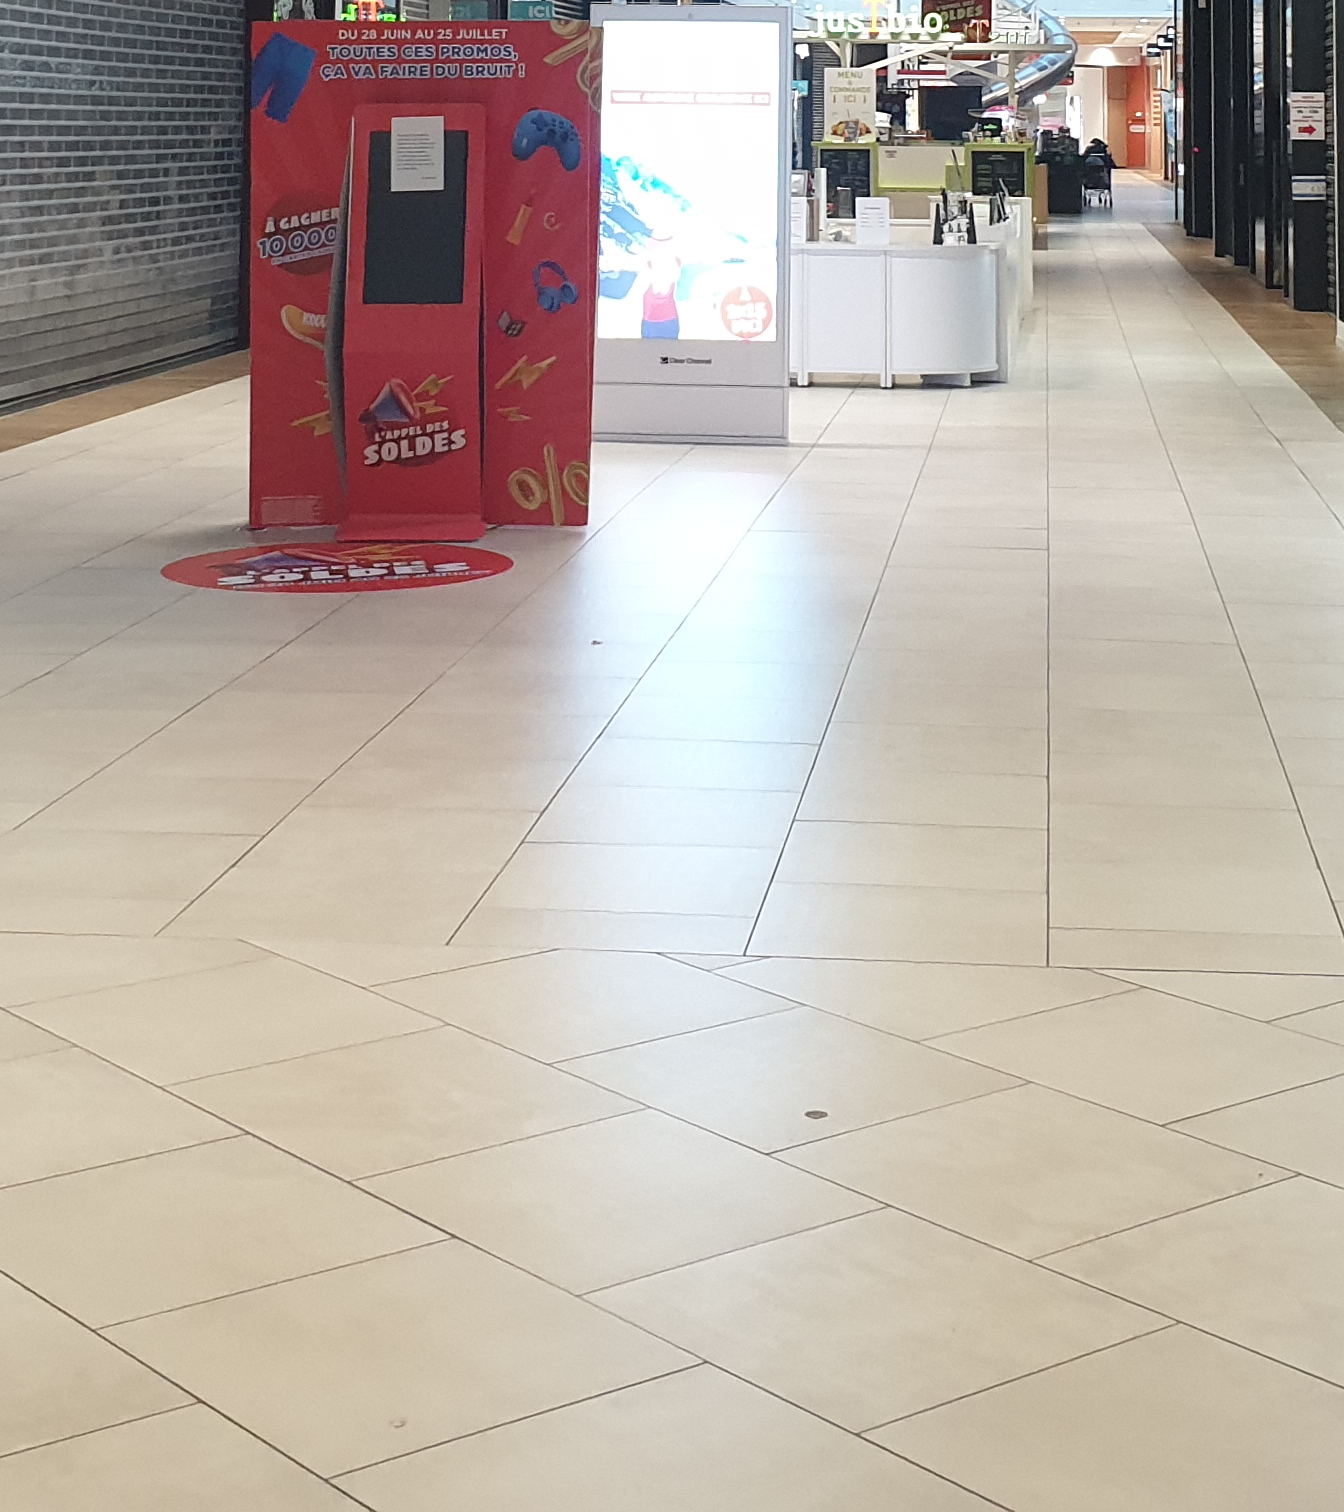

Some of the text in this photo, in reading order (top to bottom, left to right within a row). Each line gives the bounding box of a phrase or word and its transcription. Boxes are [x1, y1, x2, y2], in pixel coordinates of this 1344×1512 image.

[941, 5, 984, 23] OLDES
[338, 28, 508, 40] DU 28 JUIN AU 25 JUILLET
[327, 45, 519, 61] TOUTES CES PROMOS,
[320, 64, 348, 81] ÇA
[351, 64, 375, 79] VA
[378, 64, 431, 79] FAIRE
[432, 64, 460, 79] DU
[463, 63, 515, 79] BRUIT
[374, 420, 450, 442] L'APPEL DES
[363, 428, 467, 465] SOLDES
[216, 562, 471, 586] SOLDES
